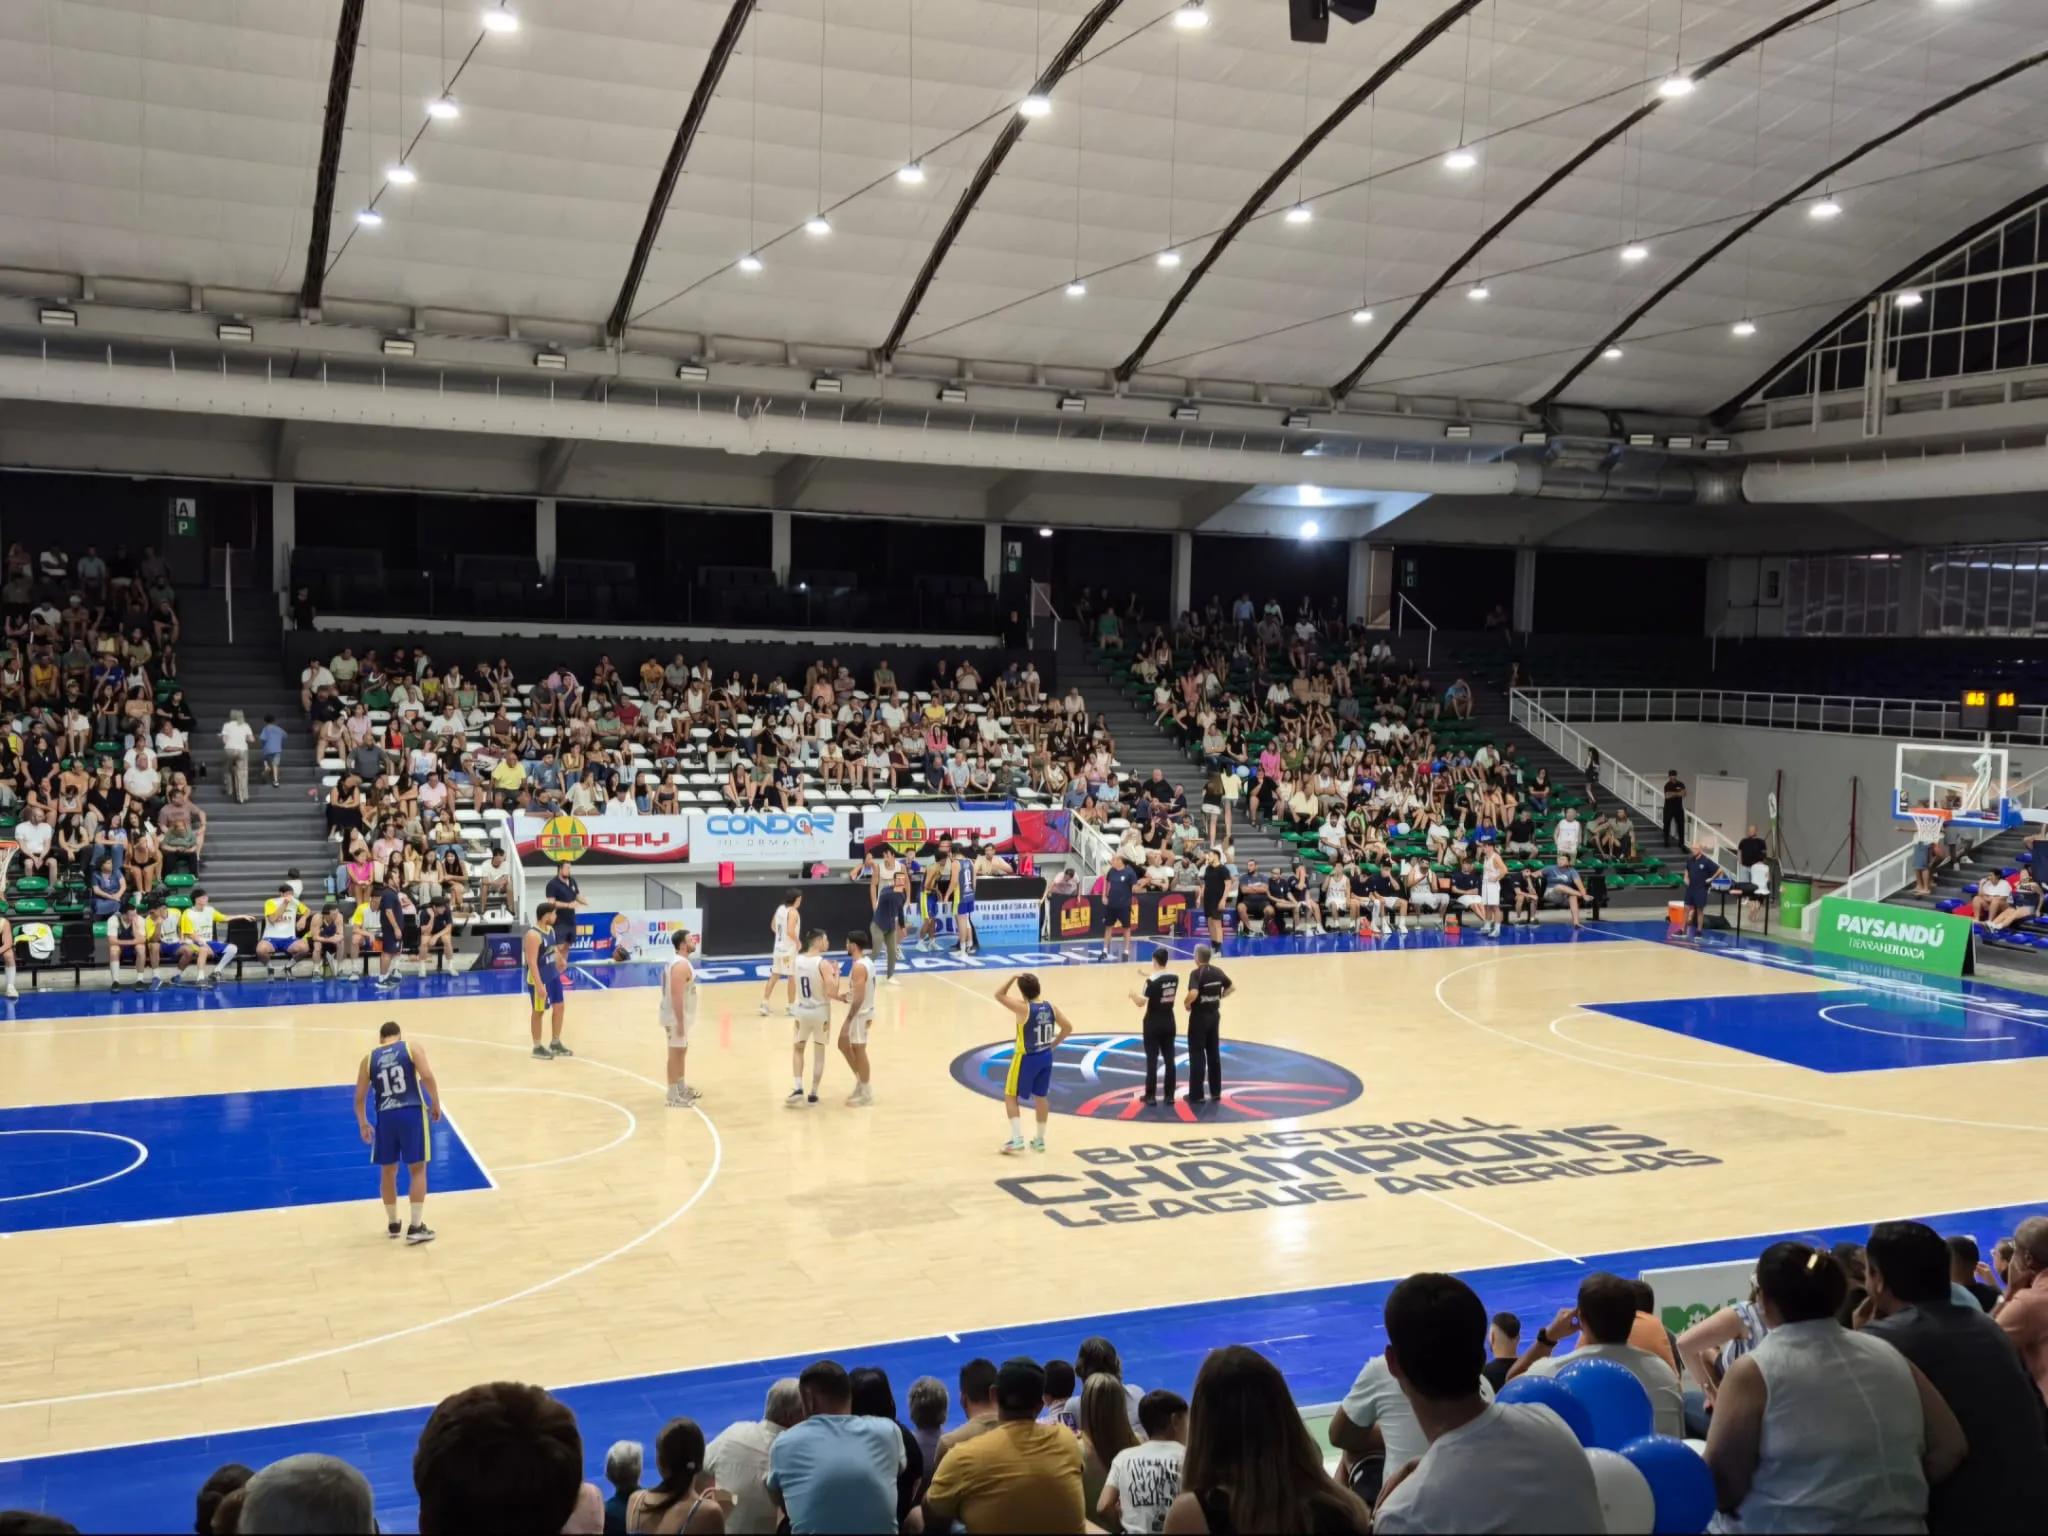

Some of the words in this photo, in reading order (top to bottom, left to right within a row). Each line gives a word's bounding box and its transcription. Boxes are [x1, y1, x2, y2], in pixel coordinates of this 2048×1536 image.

[179, 502, 188, 516] A
[179, 521, 188, 535] P
[707, 814, 834, 835] CONDOR
[1837, 914, 1944, 947] PAYSANDÚ
[1034, 1023, 1056, 1046] 10
[377, 1065, 406, 1097] 13
[1074, 1117, 1521, 1164] BASKETBALL
[995, 1125, 1667, 1205] CHAMPIONS
[1044, 1181, 1367, 1228] LEAGUE
[1375, 1149, 1724, 1194] AMERICAS
